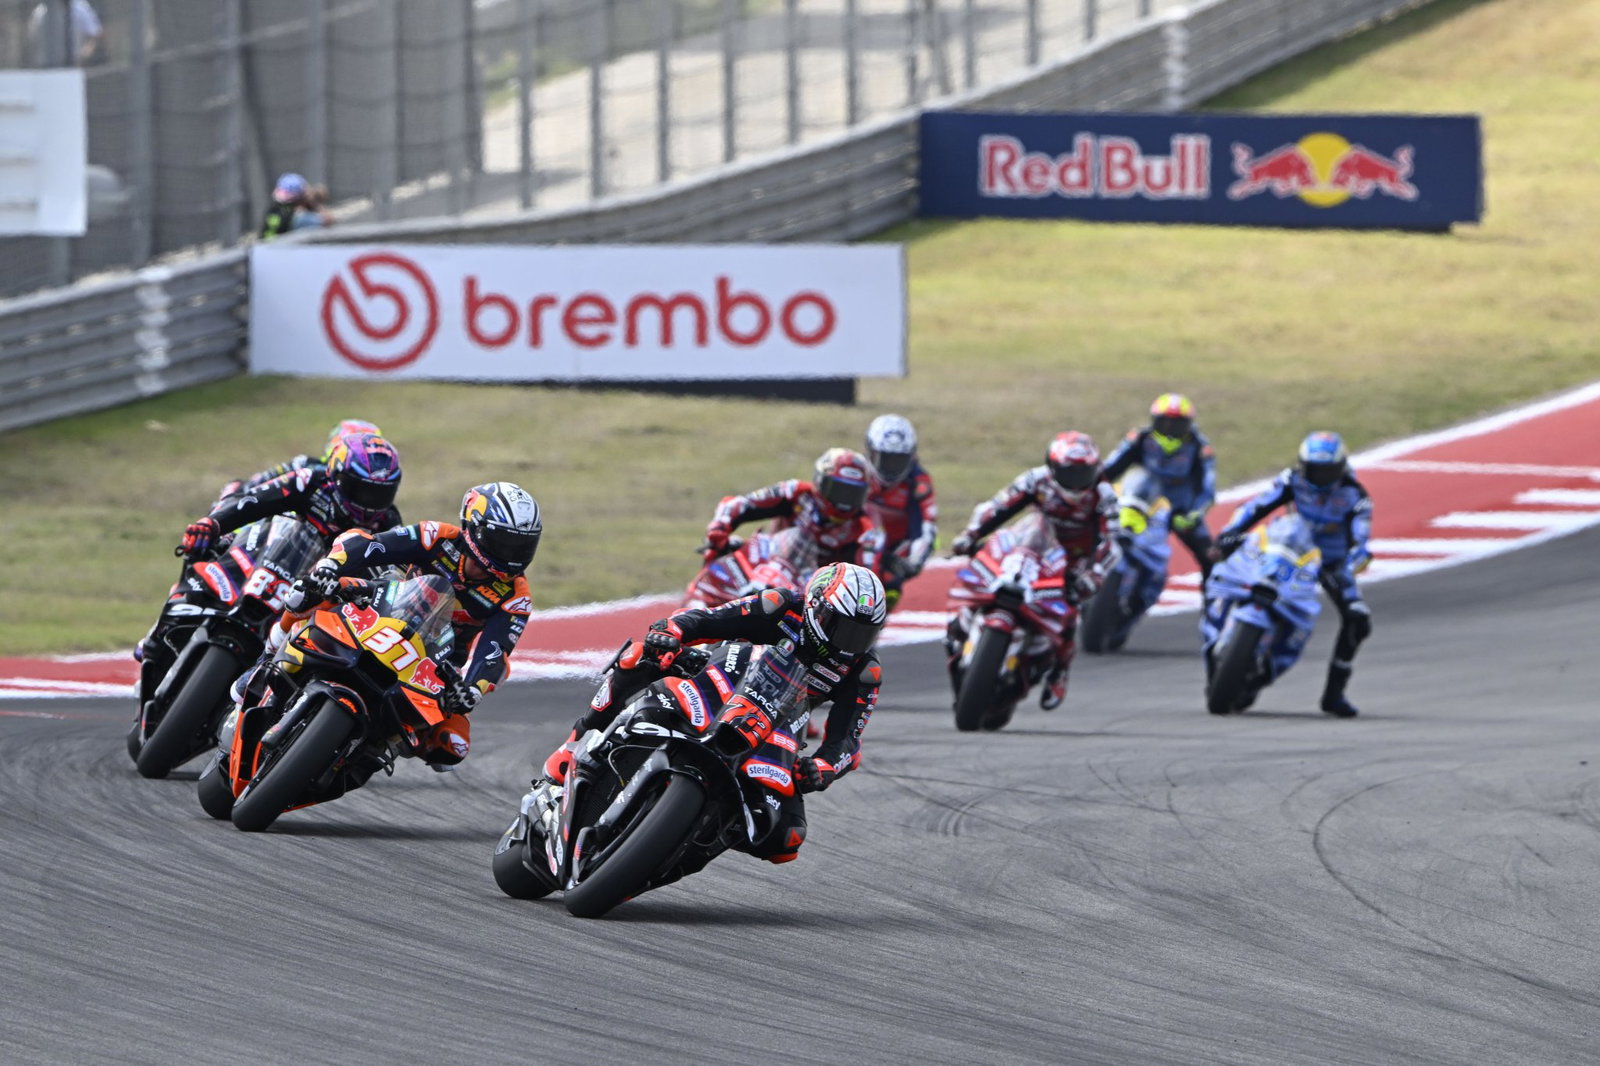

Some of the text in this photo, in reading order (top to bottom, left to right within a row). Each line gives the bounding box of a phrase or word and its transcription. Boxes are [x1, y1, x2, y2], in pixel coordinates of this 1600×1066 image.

[979, 133, 1211, 199] Red Bull
[463, 275, 837, 349] brembo
[361, 625, 421, 673] 37
[656, 693, 674, 711] sky
[679, 682, 704, 724] sterilgarda
[744, 686, 779, 720] TARGA
[749, 764, 789, 786] sterilgarda
[766, 794, 781, 811] sky
